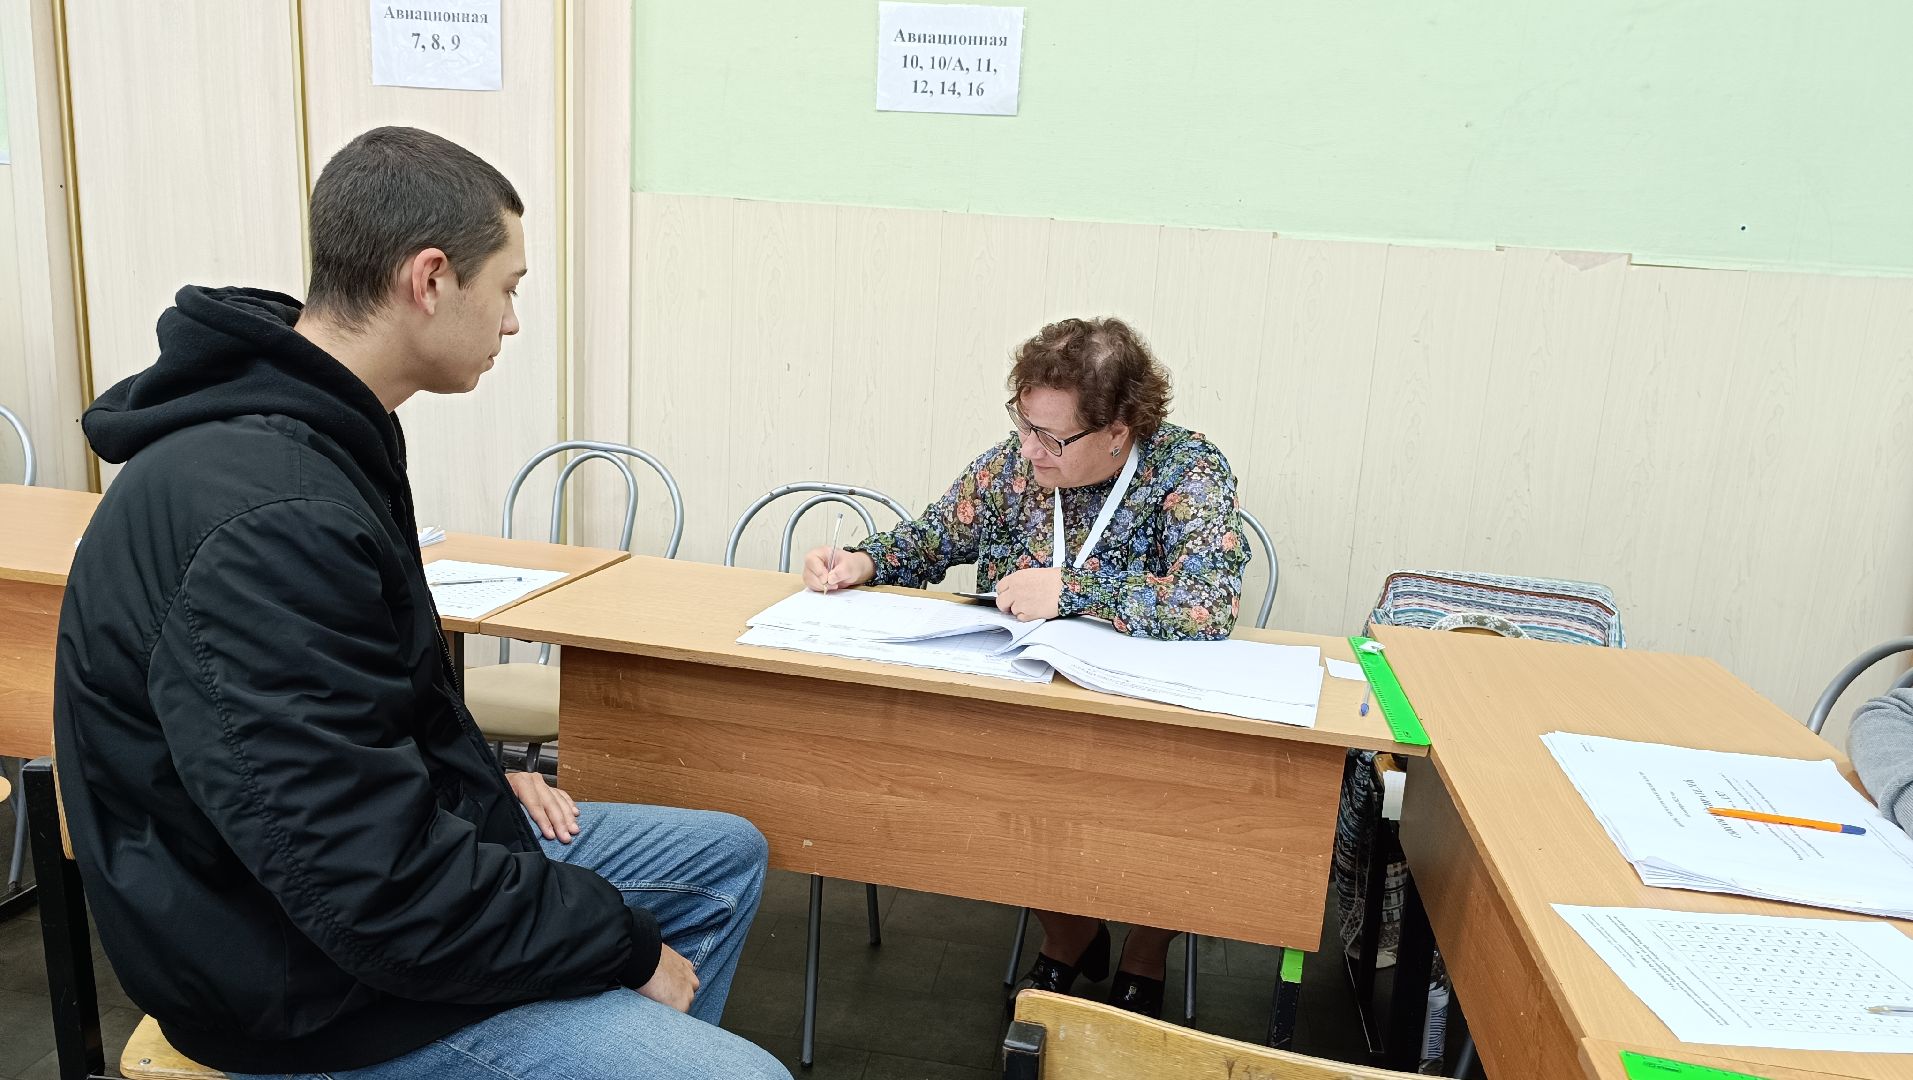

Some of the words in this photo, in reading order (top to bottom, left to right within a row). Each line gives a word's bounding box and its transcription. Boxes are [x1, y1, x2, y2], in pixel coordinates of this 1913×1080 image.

[384, 5, 488, 24] Авиационная
[411, 32, 426, 52] 7,
[451, 34, 460, 52] 9
[893, 27, 1008, 46] Авиационная
[902, 54, 923, 72] 10,
[930, 55, 970, 74] 10/А,
[976, 57, 997, 75] 11,
[912, 79, 934, 97] 12,
[940, 81, 961, 98] 14,
[967, 82, 985, 96] 16
